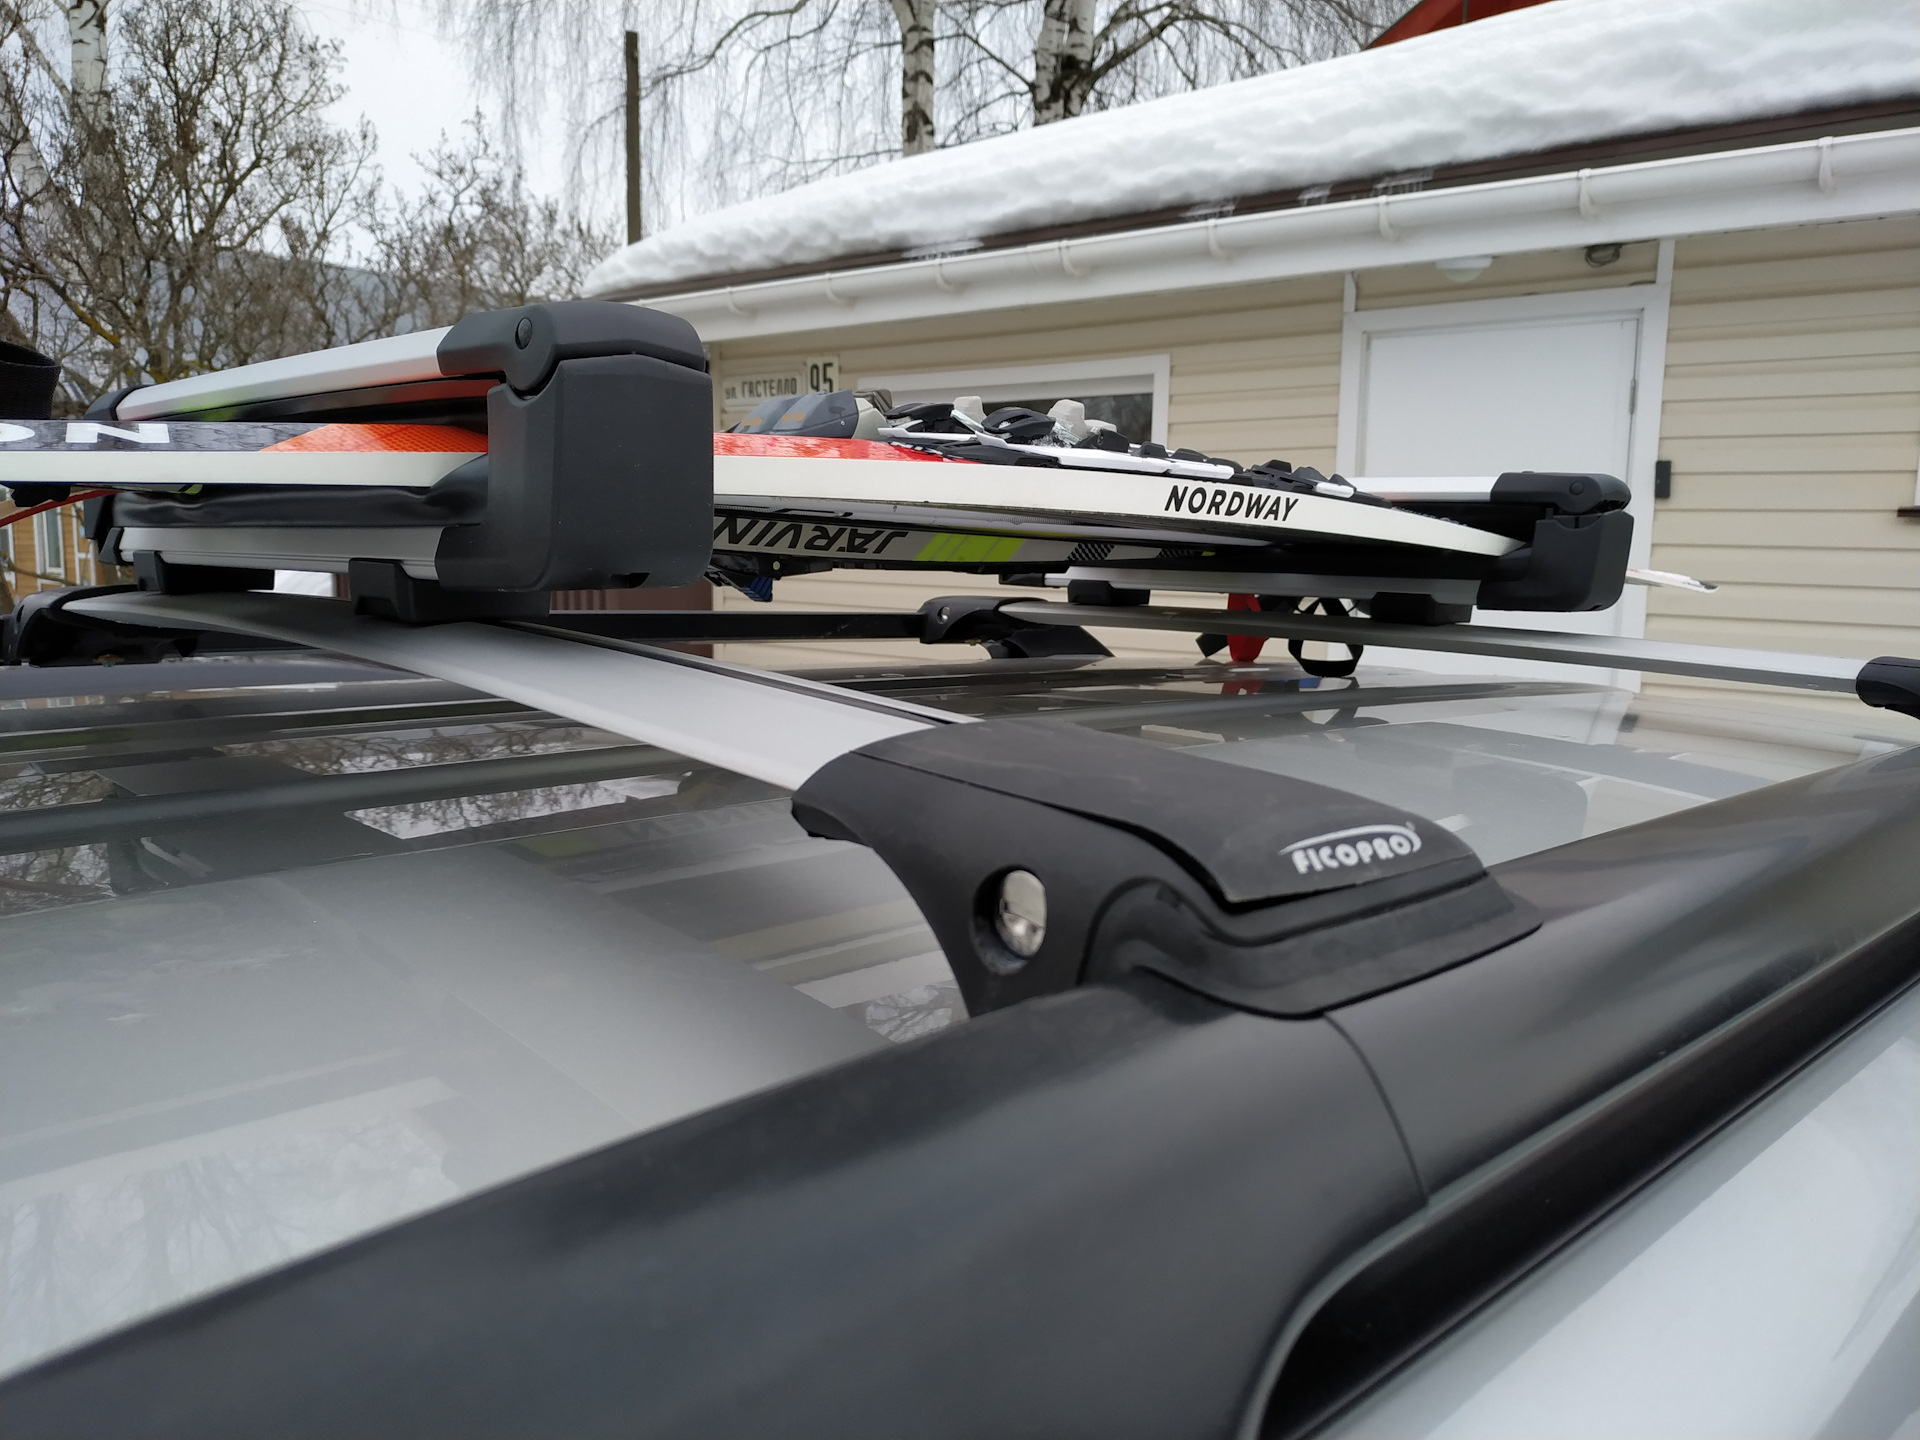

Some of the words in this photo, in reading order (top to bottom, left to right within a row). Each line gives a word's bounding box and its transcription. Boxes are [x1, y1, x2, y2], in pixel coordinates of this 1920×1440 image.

[741, 377, 798, 398] ГАСТЕЛЛО
[809, 362, 834, 393] 95
[1164, 484, 1300, 522] NORDWAY
[1291, 834, 1412, 875] FICOPRO
